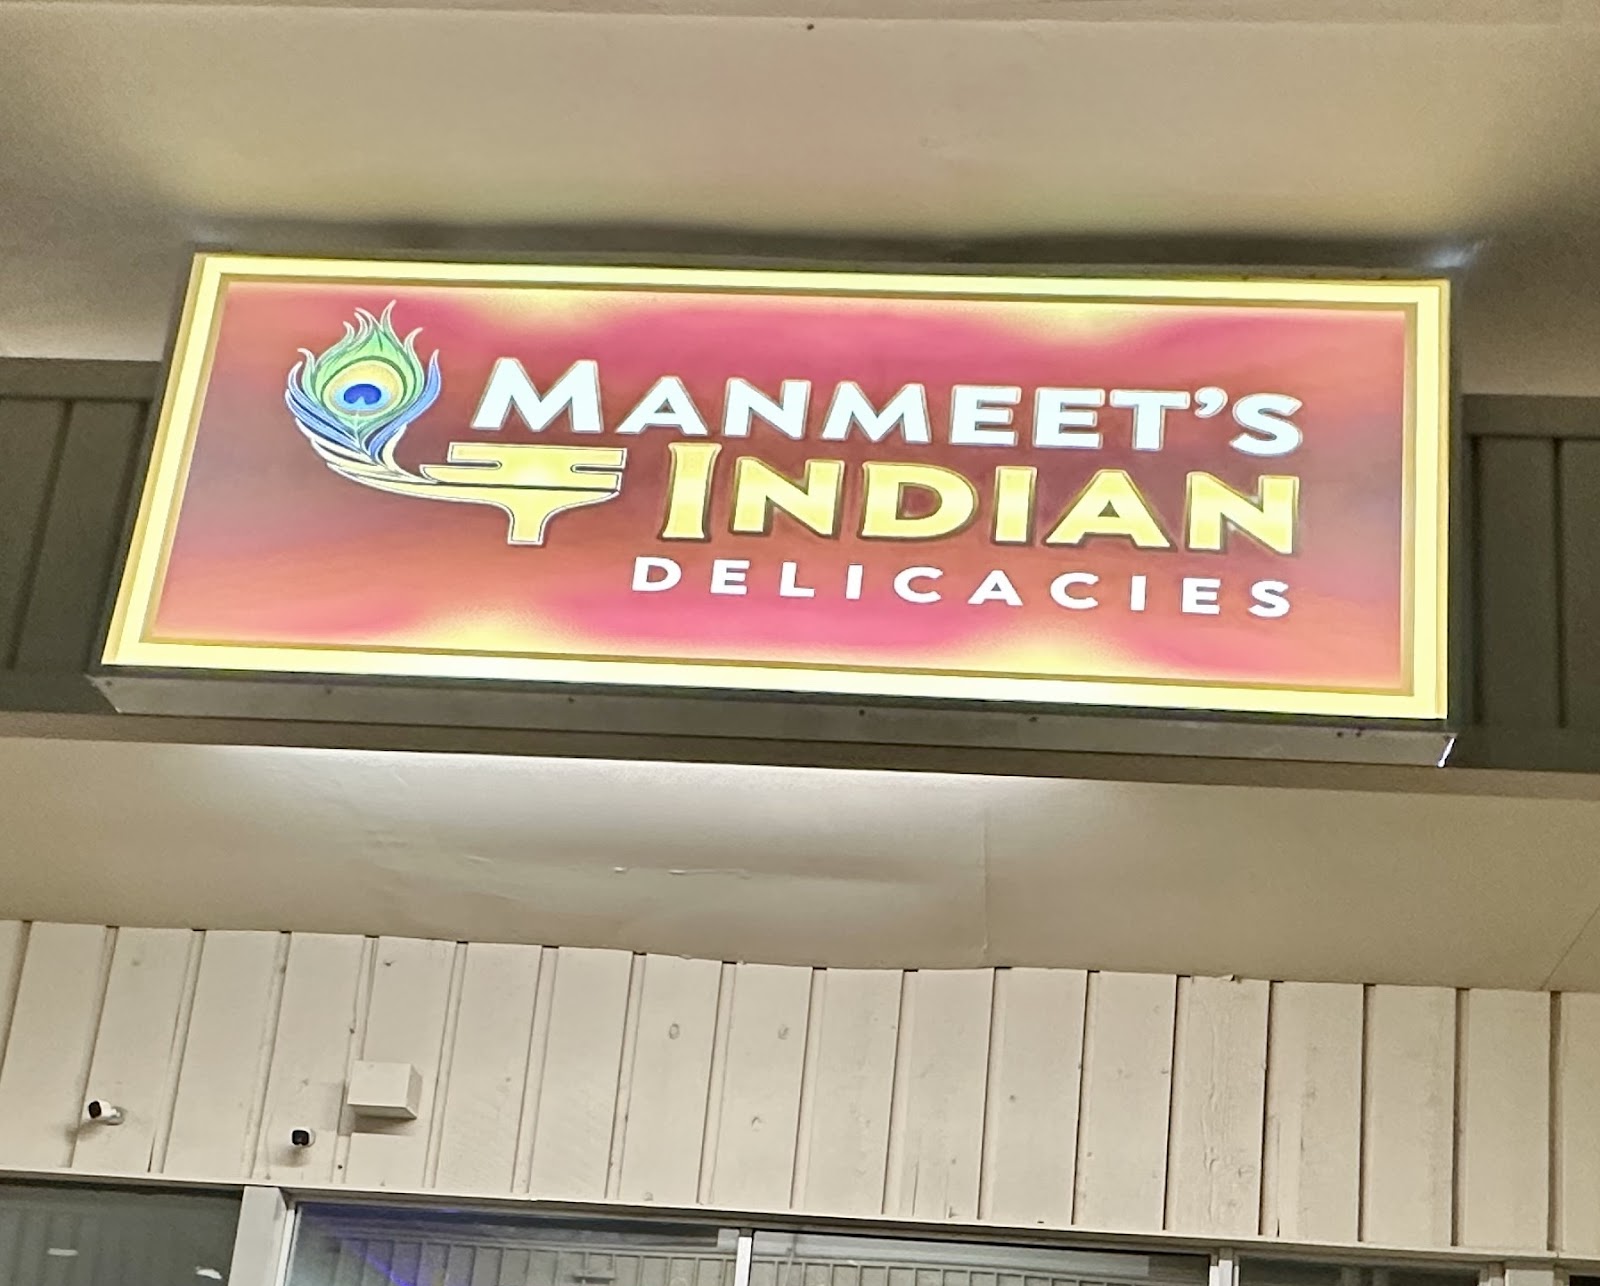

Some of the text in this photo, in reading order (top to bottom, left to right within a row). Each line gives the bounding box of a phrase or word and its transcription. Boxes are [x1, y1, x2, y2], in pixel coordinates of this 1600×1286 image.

[471, 357, 1303, 457] MANMEET'S
[661, 441, 1301, 556] INDIAN
[631, 555, 1291, 619] DELICACIES
